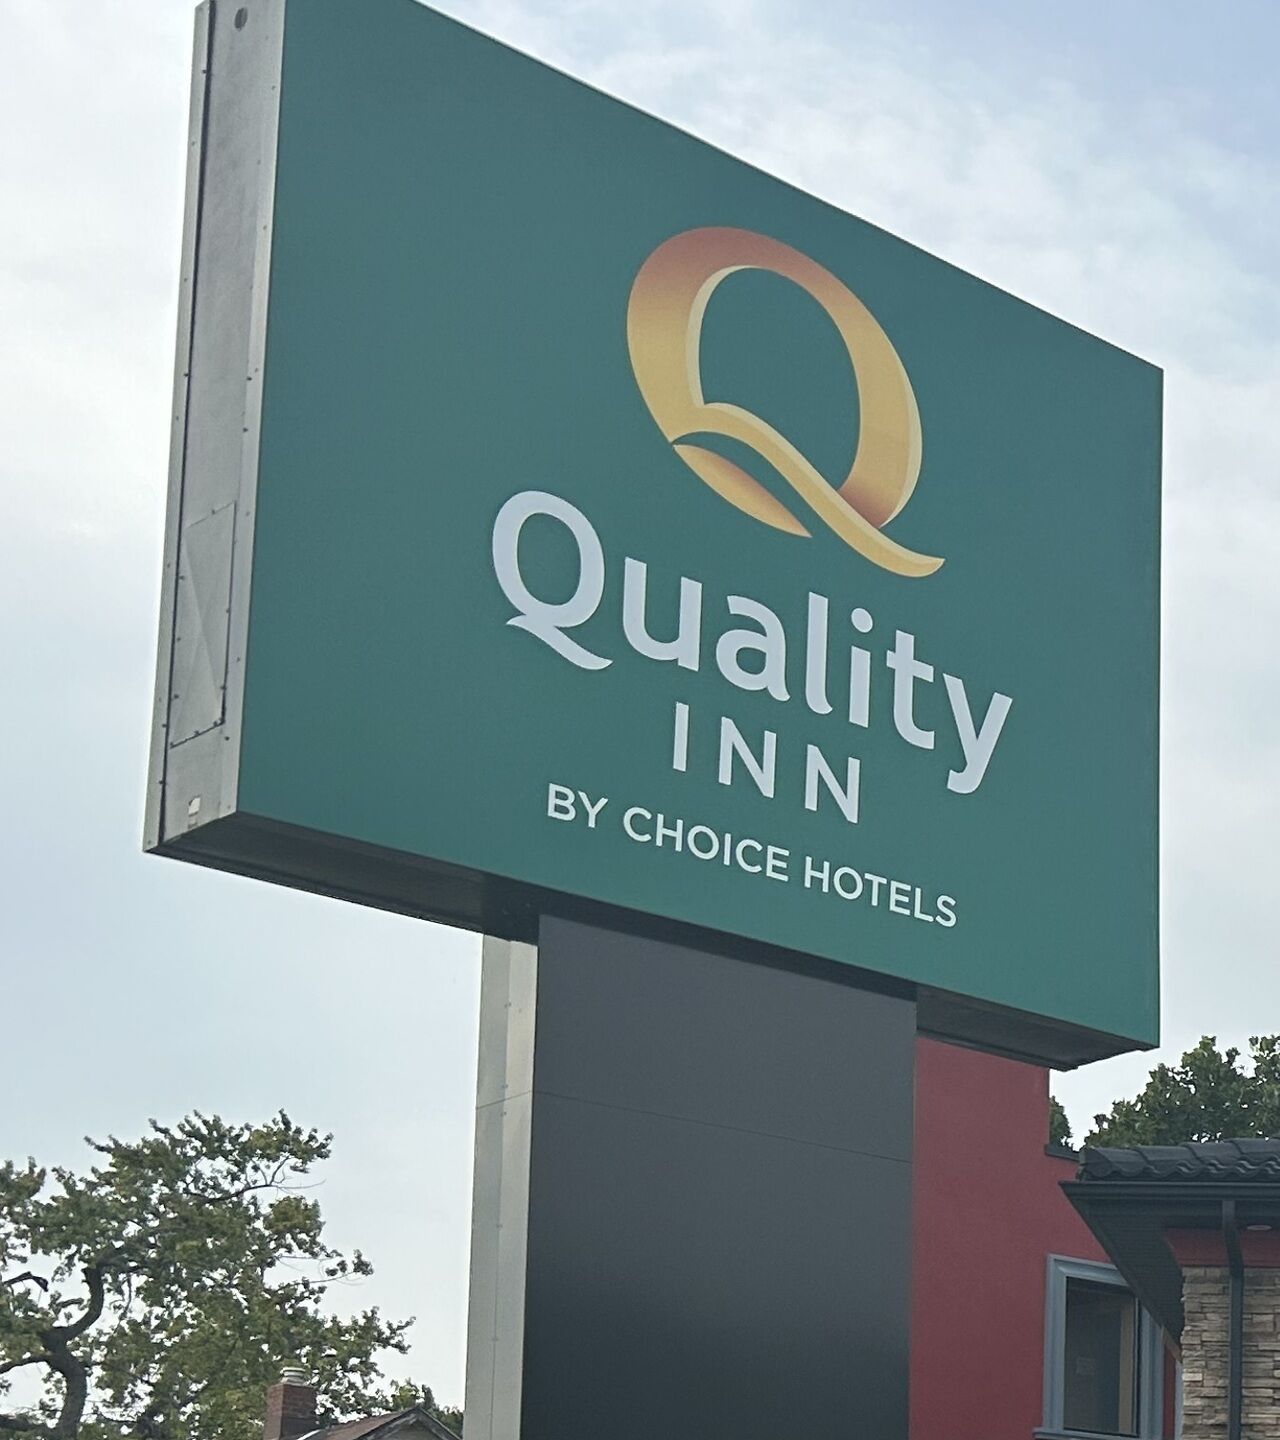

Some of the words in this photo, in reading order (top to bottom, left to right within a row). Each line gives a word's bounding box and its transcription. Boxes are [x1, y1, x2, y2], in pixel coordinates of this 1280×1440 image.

[627, 227, 945, 577] Q
[492, 490, 1013, 794] Quality
[547, 783, 608, 829] BY
[623, 806, 790, 882] CHOICE
[804, 856, 957, 928] HOTELS
[673, 701, 861, 824] INN
